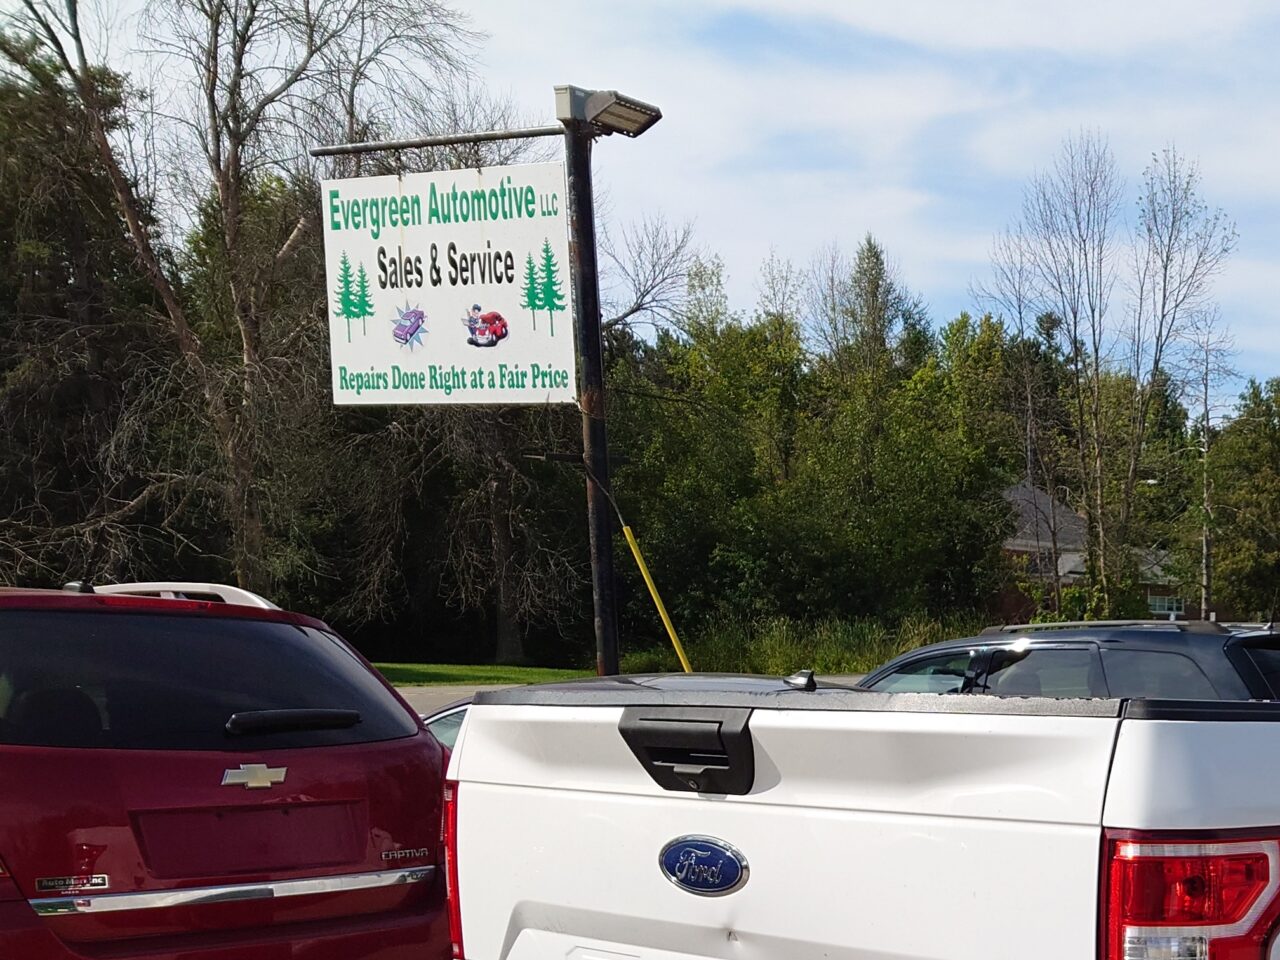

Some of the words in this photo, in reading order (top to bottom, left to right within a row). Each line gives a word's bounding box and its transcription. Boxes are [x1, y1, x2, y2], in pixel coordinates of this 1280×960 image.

[328, 190, 421, 239] Evergreen
[428, 176, 536, 225] Automotive
[540, 193, 559, 217] LLC
[377, 245, 424, 290] Sales
[430, 243, 442, 287] &
[447, 240, 515, 286] Service
[338, 366, 389, 396] Repairs
[391, 365, 426, 390] Done
[428, 363, 468, 396] Right
[470, 367, 485, 389] at
[488, 373, 496, 389] a
[498, 363, 528, 389] Fair
[530, 364, 569, 389] Price
[381, 847, 429, 860] CAPTIVA
[675, 847, 722, 884] Ford
